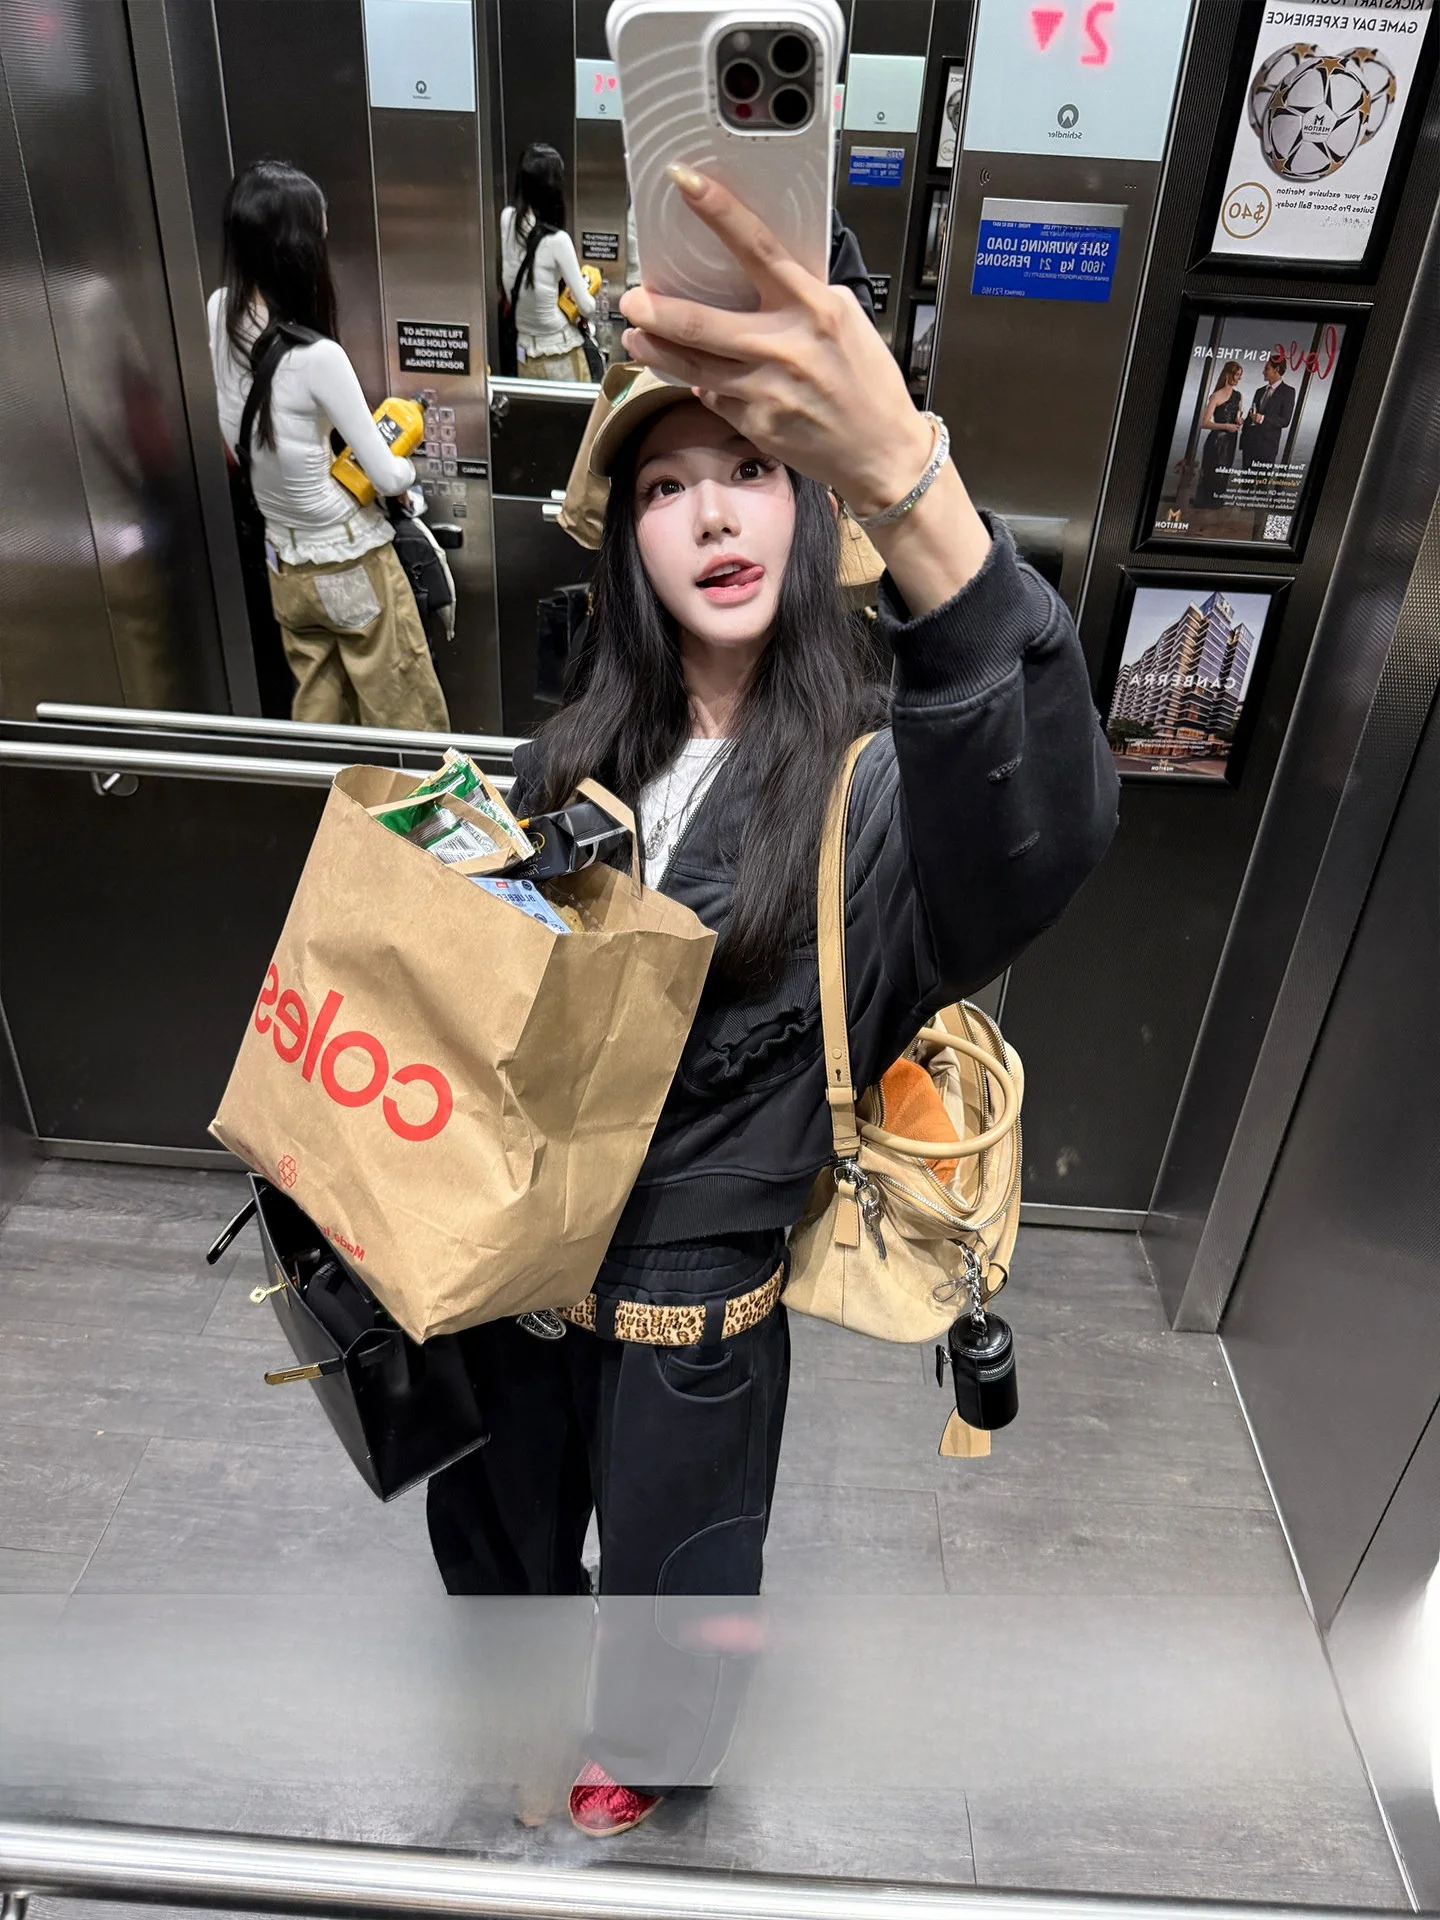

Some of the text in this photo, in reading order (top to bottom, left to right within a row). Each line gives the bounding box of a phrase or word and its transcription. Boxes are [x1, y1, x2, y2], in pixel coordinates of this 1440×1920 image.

[403, 326, 414, 336] TO
[415, 327, 448, 338] ACTIVATE
[400, 336, 468, 350] PLEASE HOLD YOUR
[439, 350, 454, 359] KEY
[405, 358, 464, 370] AGAINST SENSOR
